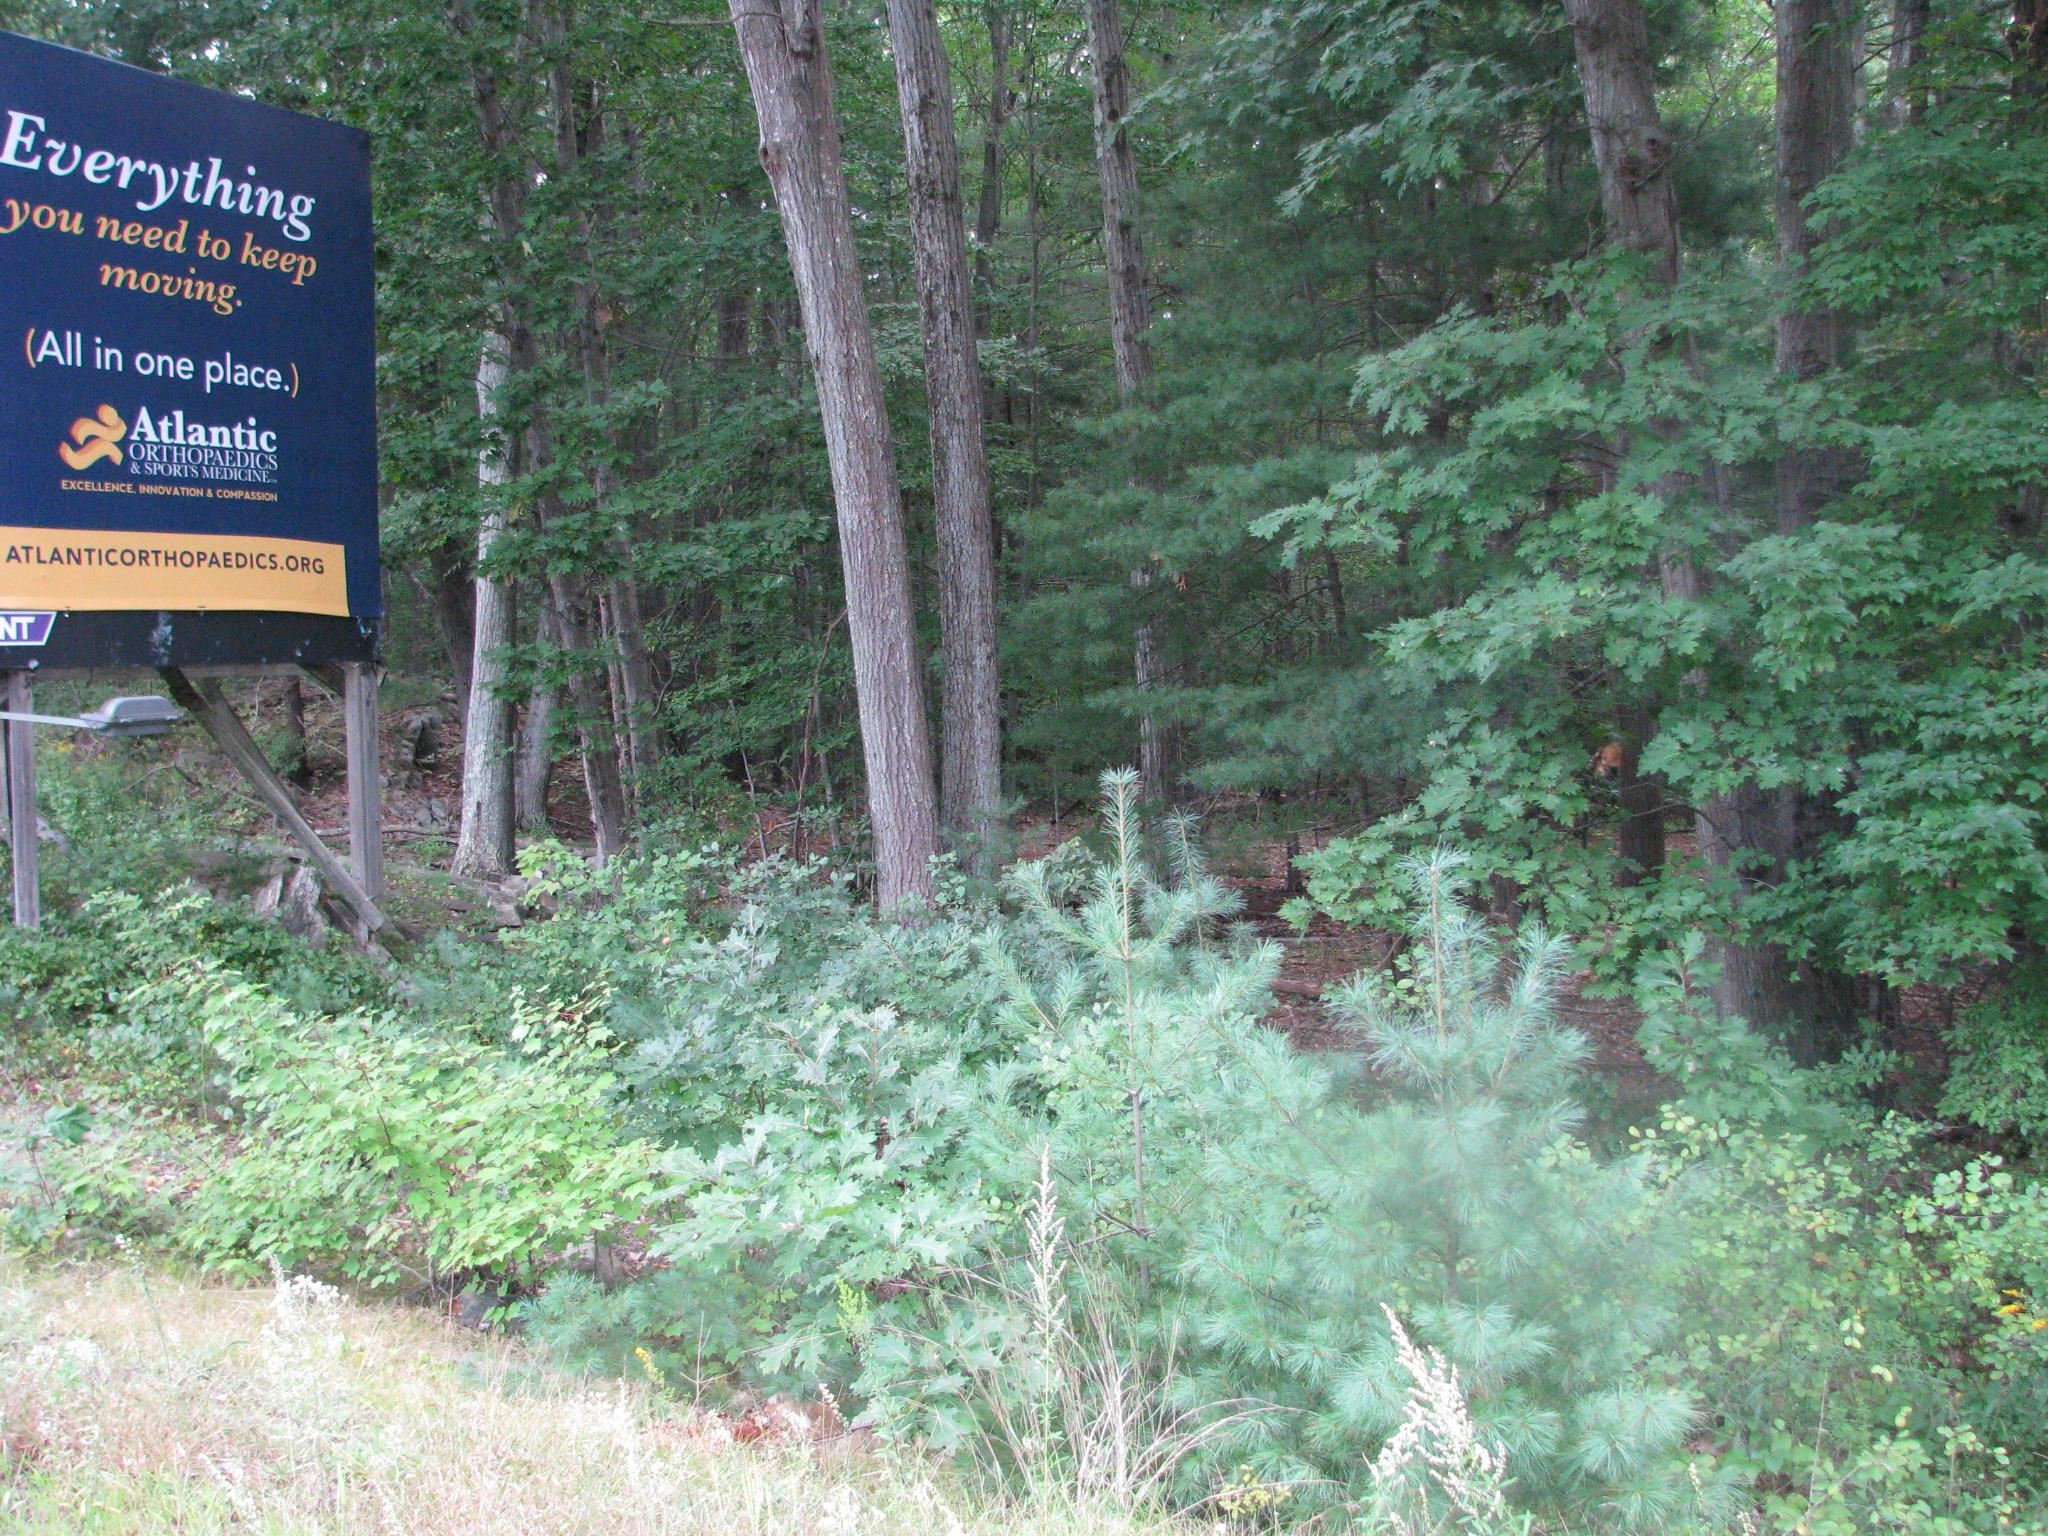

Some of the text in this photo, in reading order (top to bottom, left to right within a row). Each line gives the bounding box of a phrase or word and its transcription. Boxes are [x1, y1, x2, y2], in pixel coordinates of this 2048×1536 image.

[0, 110, 316, 242] Everything
[0, 198, 317, 286] you need to keep
[99, 263, 243, 315] moving.
[25, 327, 299, 398] (All in one place.)
[129, 406, 278, 453] Atlantic
[129, 443, 278, 470] ORTHOPAEDICS
[130, 461, 271, 483] & SPORTS MEDICINE
[139, 485, 203, 498] INNOVATION
[206, 488, 213, 497] &
[216, 489, 278, 502] COMPASSION
[6, 545, 325, 575] ATLANTICORTHOPAEDICS.ORG
